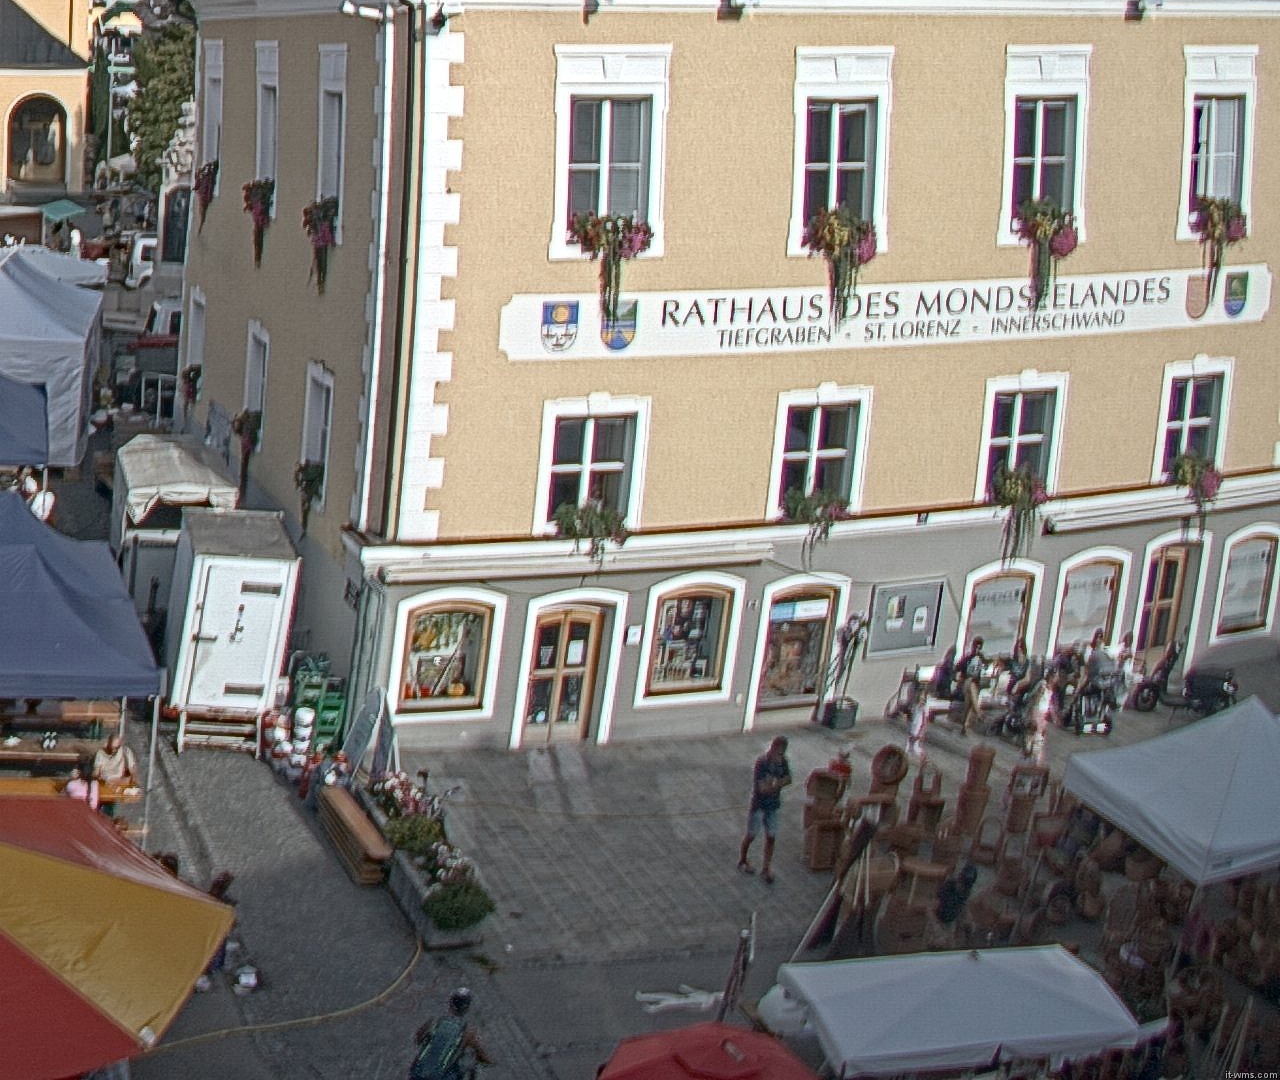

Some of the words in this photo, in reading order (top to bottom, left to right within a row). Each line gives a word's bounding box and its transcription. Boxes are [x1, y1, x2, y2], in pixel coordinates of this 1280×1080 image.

[661, 294, 824, 327] RATHAUS
[915, 277, 1171, 317] MONDSELANDES
[717, 326, 832, 349] TIEFGRABEN
[864, 322, 887, 341] ST.
[892, 318, 961, 340] LORENZ
[990, 309, 1126, 335] INNERSCHWAND
